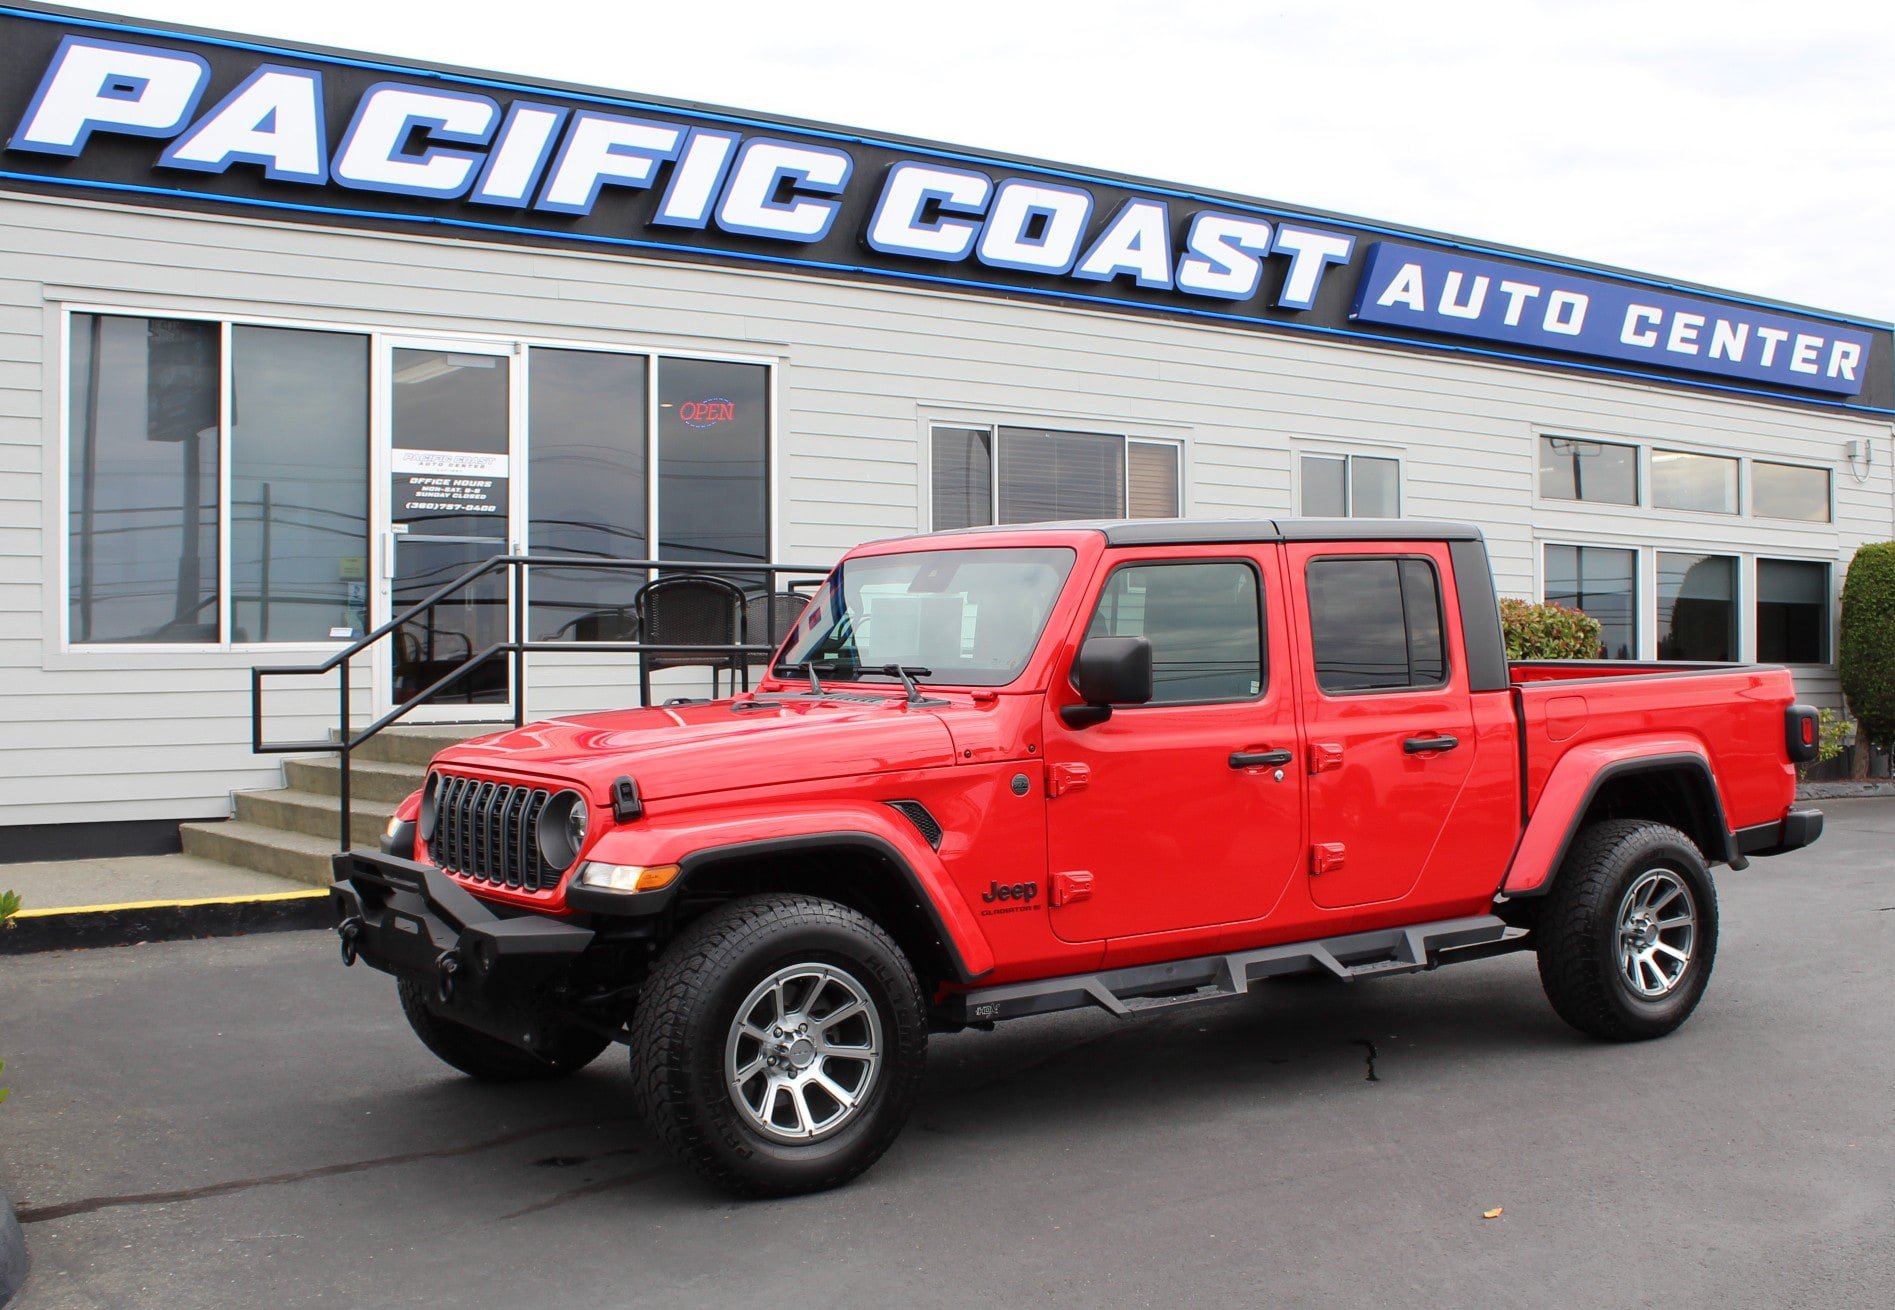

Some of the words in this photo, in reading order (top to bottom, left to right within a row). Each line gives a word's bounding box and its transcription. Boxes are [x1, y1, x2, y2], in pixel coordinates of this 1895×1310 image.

[6, 34, 854, 243] PACIFIC
[866, 160, 1357, 310] COAST
[1377, 263, 1589, 336] AUTO
[1620, 304, 1861, 380] CENTER
[679, 401, 735, 421] OPEN
[409, 477, 451, 486] OFFICE
[453, 479, 493, 487] HOURS
[982, 880, 1038, 903] Jeep
[981, 905, 1032, 916] GLADIATOR
